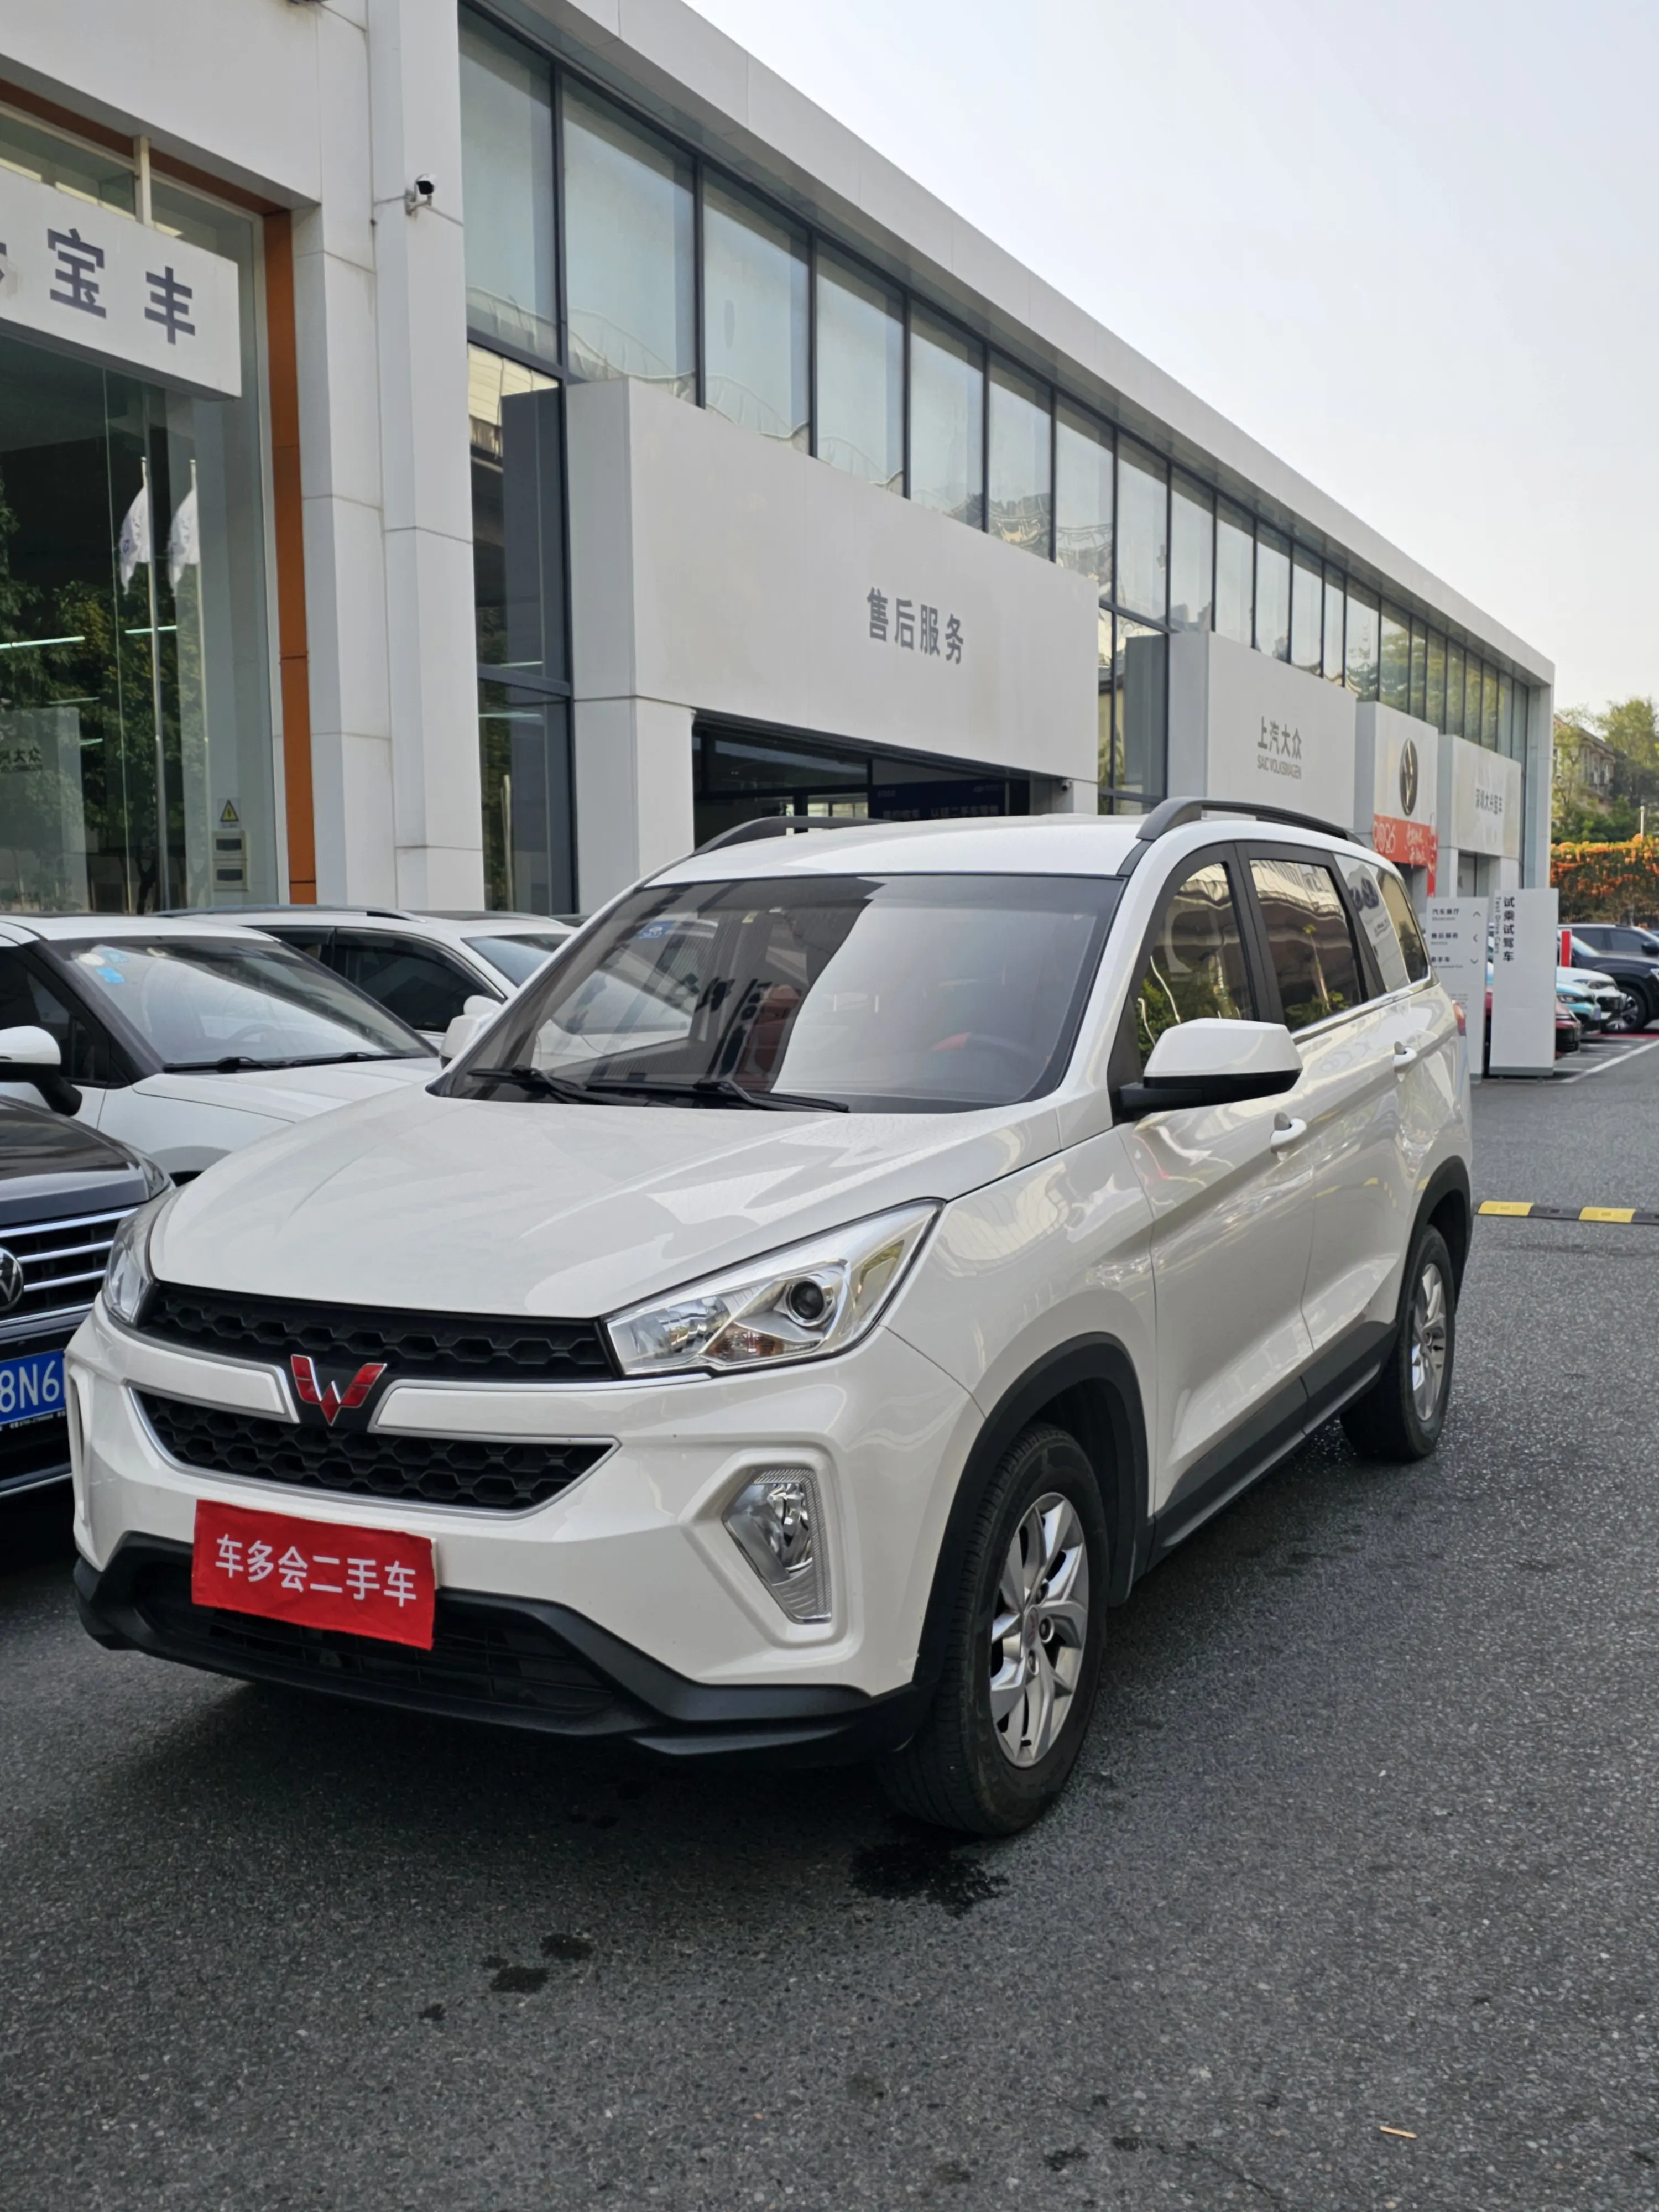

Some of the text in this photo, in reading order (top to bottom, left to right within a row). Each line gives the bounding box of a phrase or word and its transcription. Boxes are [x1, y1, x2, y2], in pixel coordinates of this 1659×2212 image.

[0, 228, 195, 345] 宝丰
[867, 586, 964, 665] 售后服务
[1257, 716, 1302, 761] 上汽大众
[1503, 896, 1515, 962] 试乘试驾车
[0, 1360, 59, 1412] 8N6
[215, 1533, 417, 1607] 车多会二手车
